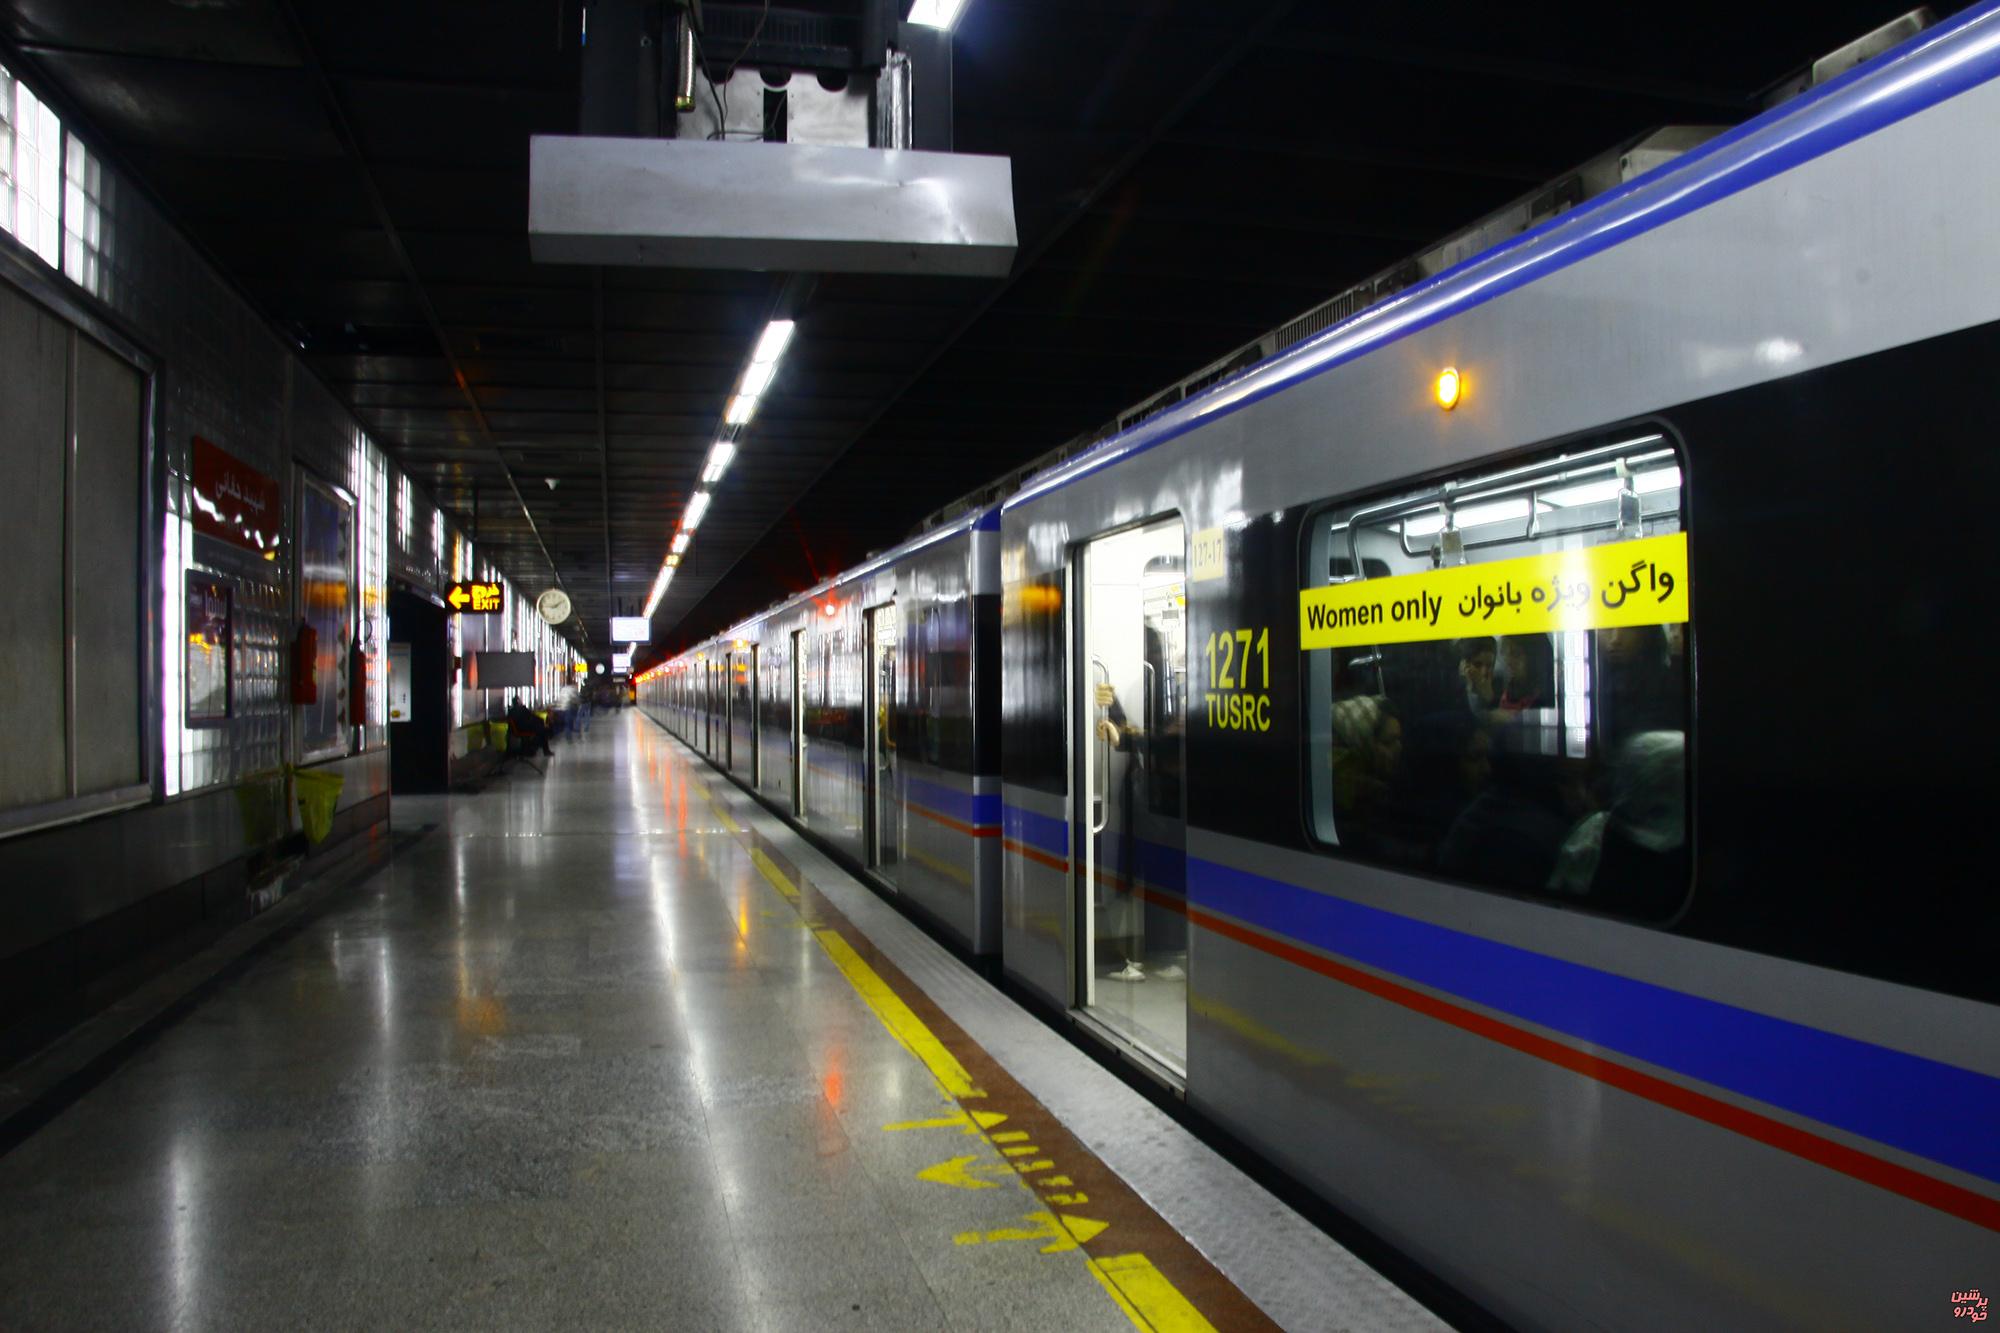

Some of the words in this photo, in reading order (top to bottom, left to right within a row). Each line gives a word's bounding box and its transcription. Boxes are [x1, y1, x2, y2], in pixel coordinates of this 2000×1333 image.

[473, 598, 500, 609] EXIT
[1458, 579, 1522, 620] بانوان
[1530, 574, 1590, 614] ویژه
[1601, 560, 1675, 610] واگن
[1307, 600, 1384, 631] Women
[1391, 591, 1443, 626] only
[1205, 627, 1269, 689] 1271
[1205, 693, 1270, 732] TUSRC
